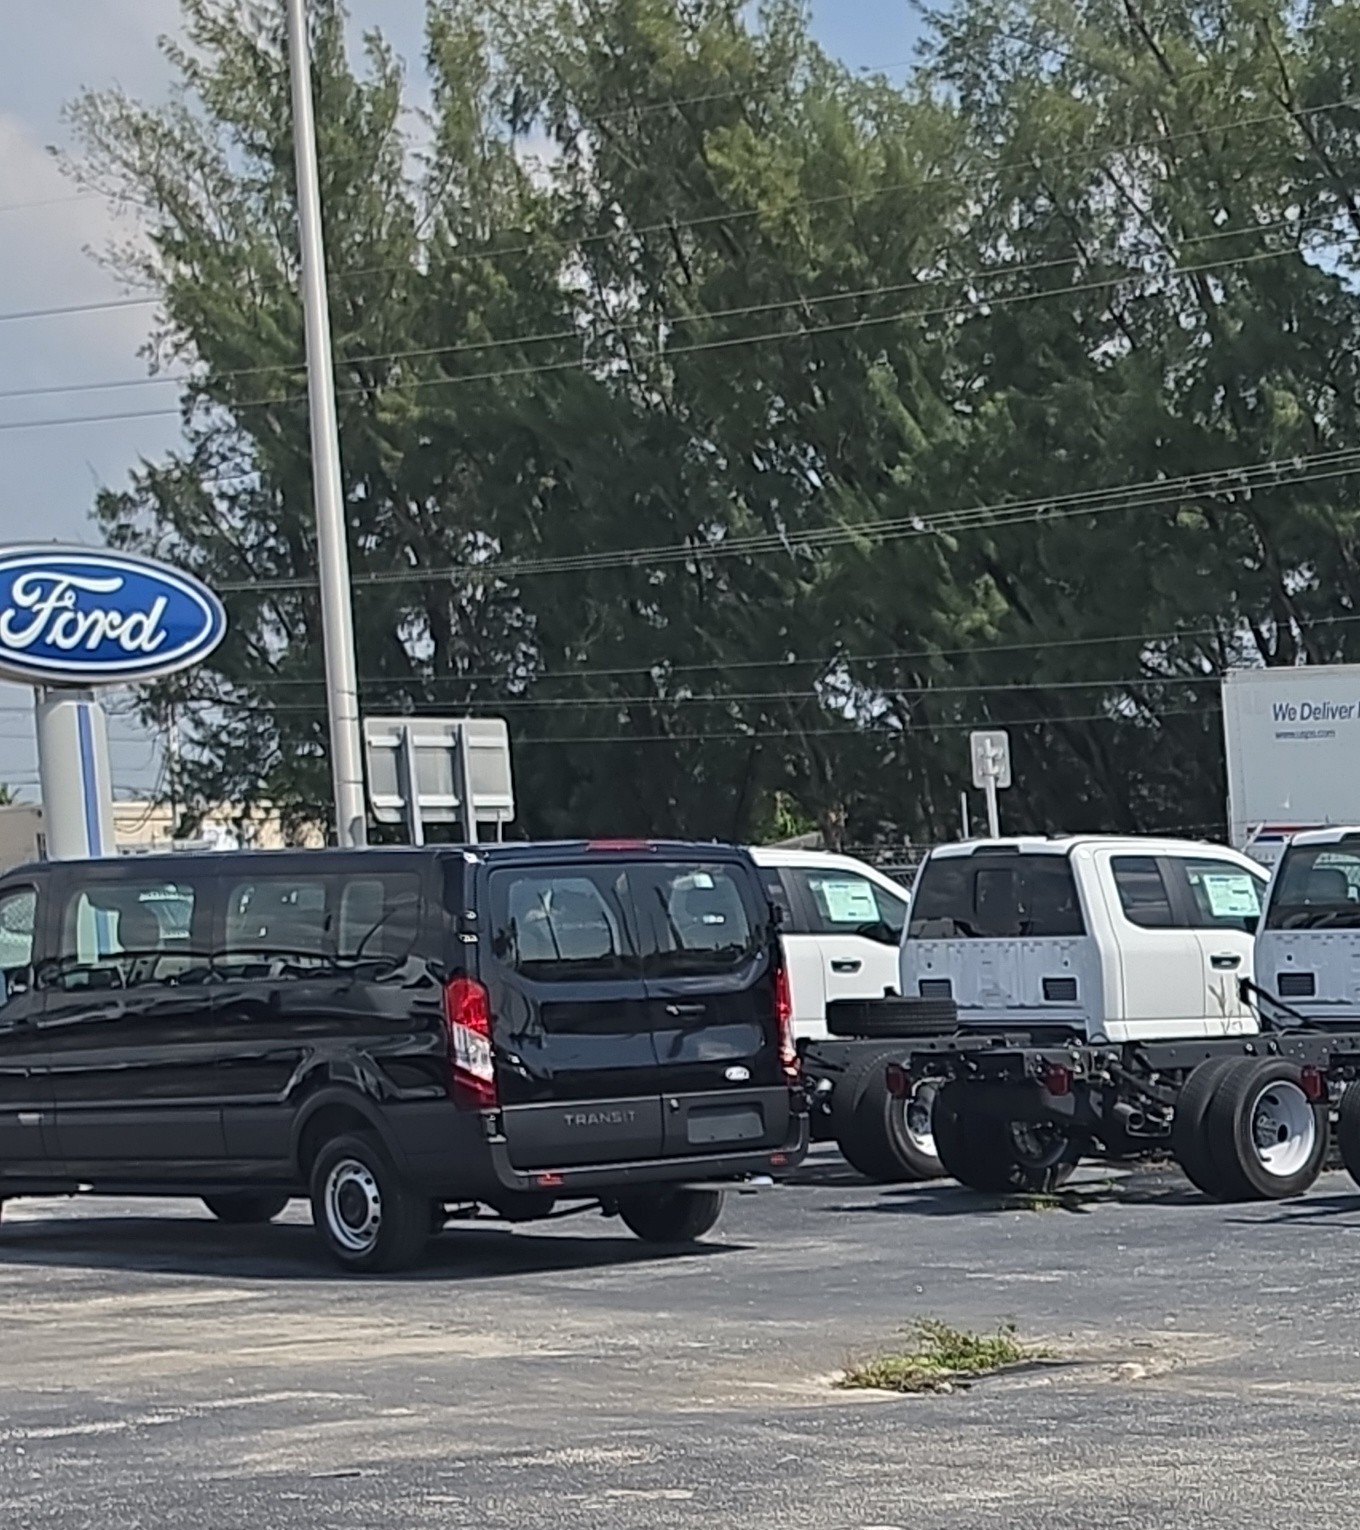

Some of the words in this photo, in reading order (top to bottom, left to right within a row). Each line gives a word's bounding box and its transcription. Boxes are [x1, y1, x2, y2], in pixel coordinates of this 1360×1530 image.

[0, 571, 169, 652] Ford
[1273, 702, 1297, 722] We
[1300, 701, 1355, 721] Deliver
[564, 1110, 636, 1127] TRANSIT
